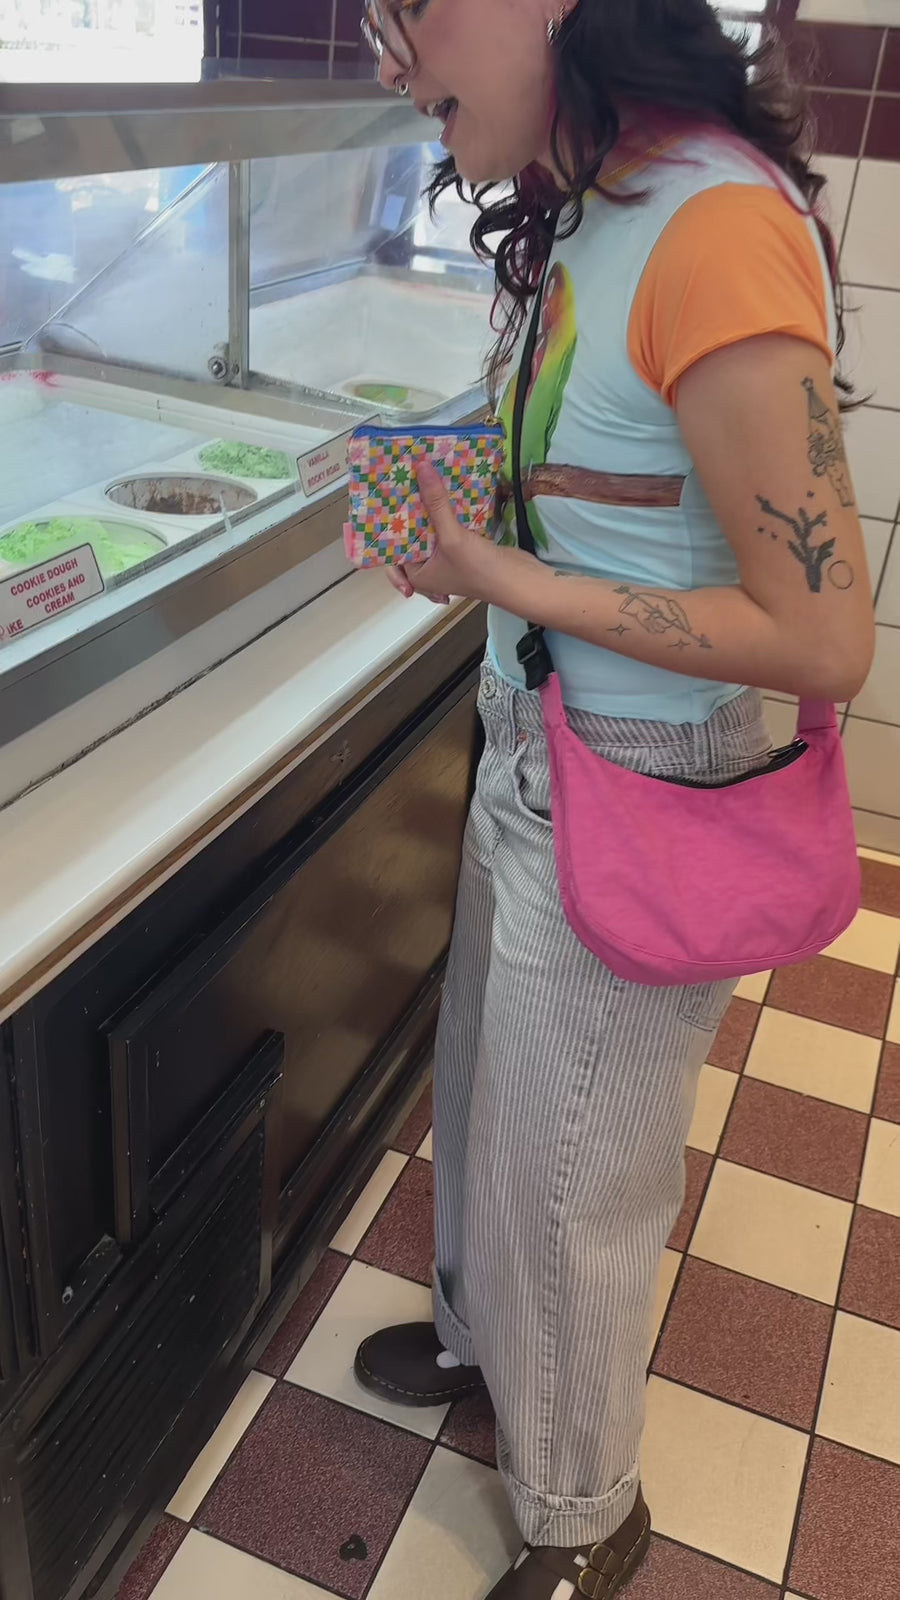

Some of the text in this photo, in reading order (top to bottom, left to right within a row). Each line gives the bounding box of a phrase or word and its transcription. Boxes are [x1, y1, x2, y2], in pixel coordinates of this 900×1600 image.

[10, 558, 79, 596] COOKIE DOUGH
[26, 573, 86, 608] COOKIES AND
[44, 591, 76, 614] CREAM
